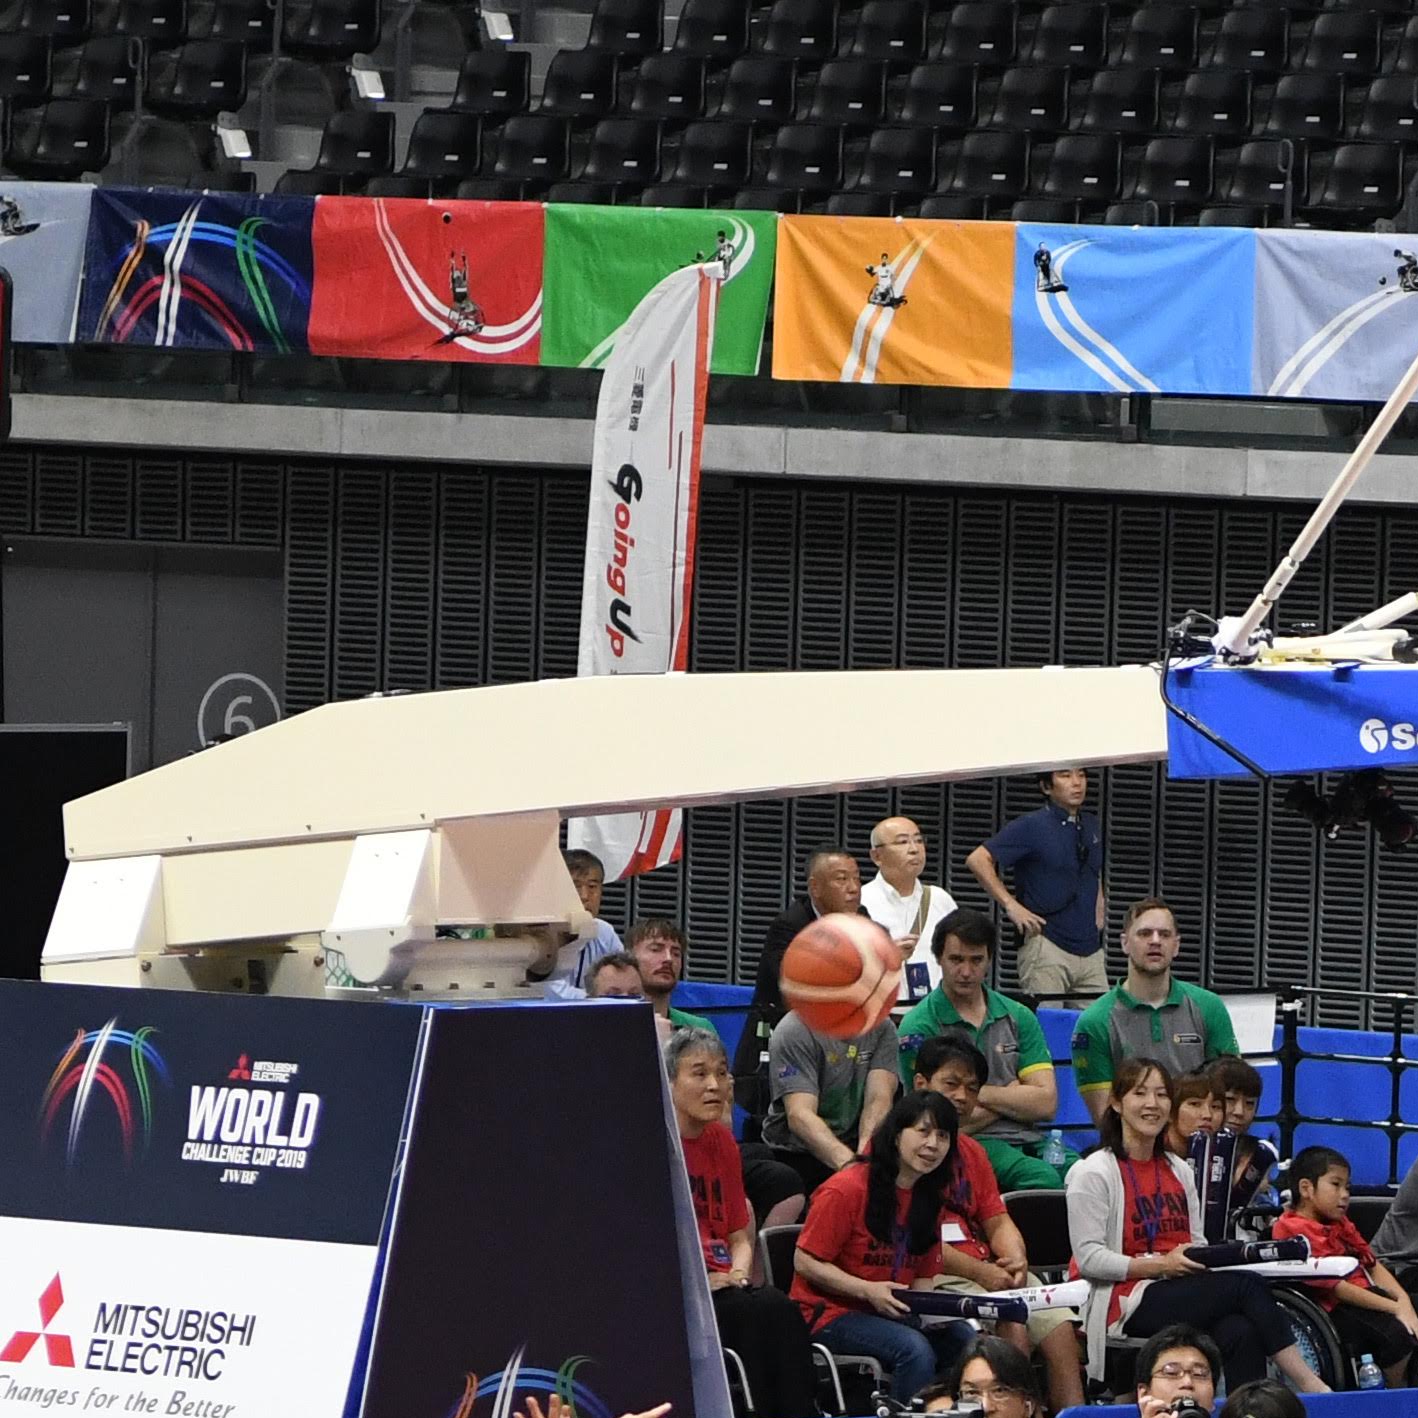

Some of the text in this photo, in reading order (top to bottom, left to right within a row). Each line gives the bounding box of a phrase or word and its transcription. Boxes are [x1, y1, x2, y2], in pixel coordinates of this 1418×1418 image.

[250, 1071, 291, 1083] ELECTRIC
[252, 1061, 299, 1075] MITSUBISHI
[187, 1085, 320, 1148] WORLD
[181, 1141, 307, 1169] CHALLENGE CUP 2019
[219, 1168, 260, 1185] JWBF
[93, 1302, 257, 1347] MITSUBISHI
[84, 1338, 226, 1381] ELECTRIC
[83, 1386, 120, 1411] for
[124, 1390, 159, 1414] the
